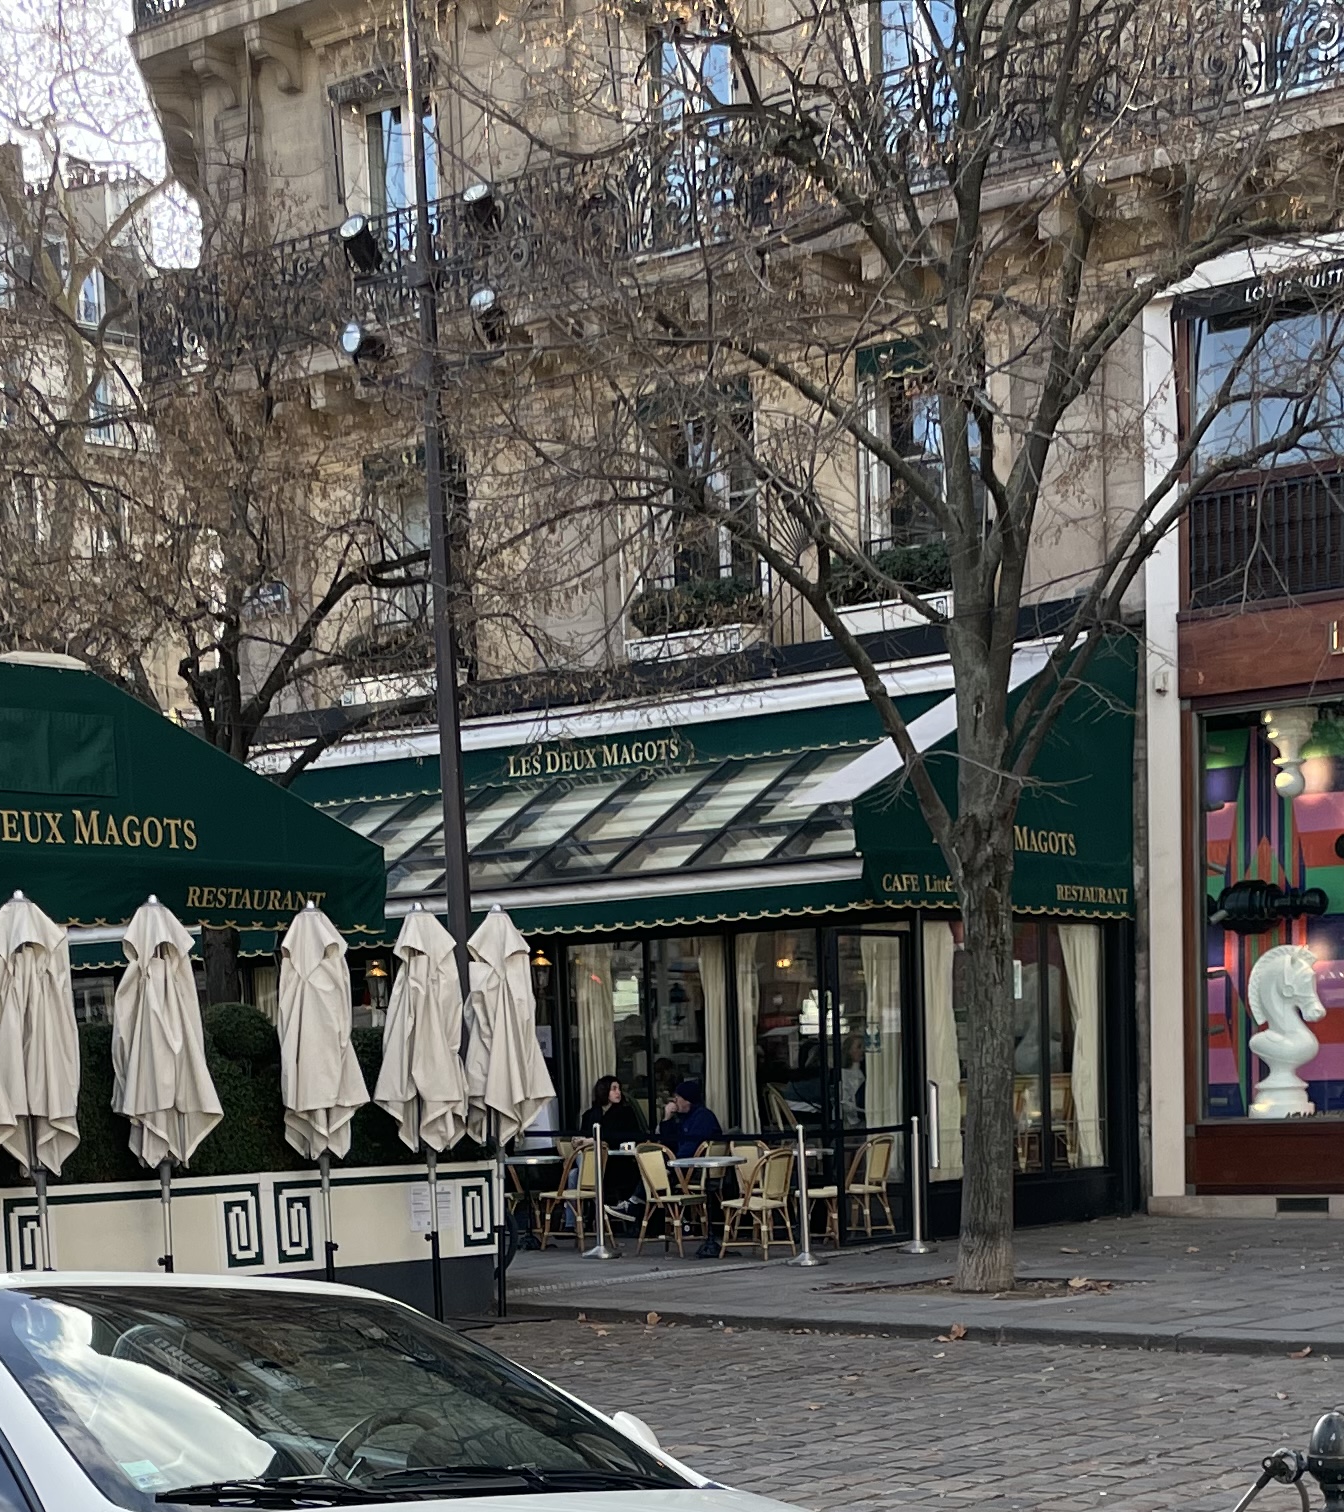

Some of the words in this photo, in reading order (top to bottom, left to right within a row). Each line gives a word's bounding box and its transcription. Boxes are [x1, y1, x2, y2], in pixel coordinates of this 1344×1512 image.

[508, 754, 542, 778] LES
[545, 748, 598, 774] DEUX
[602, 738, 679, 767] MAGOTS
[72, 809, 198, 850] MAGOTS
[1013, 825, 1077, 857] MAGOTS
[882, 873, 921, 893] CAFE
[1056, 884, 1129, 905] RESTAURANT
[186, 886, 326, 911] RESTAURANT
